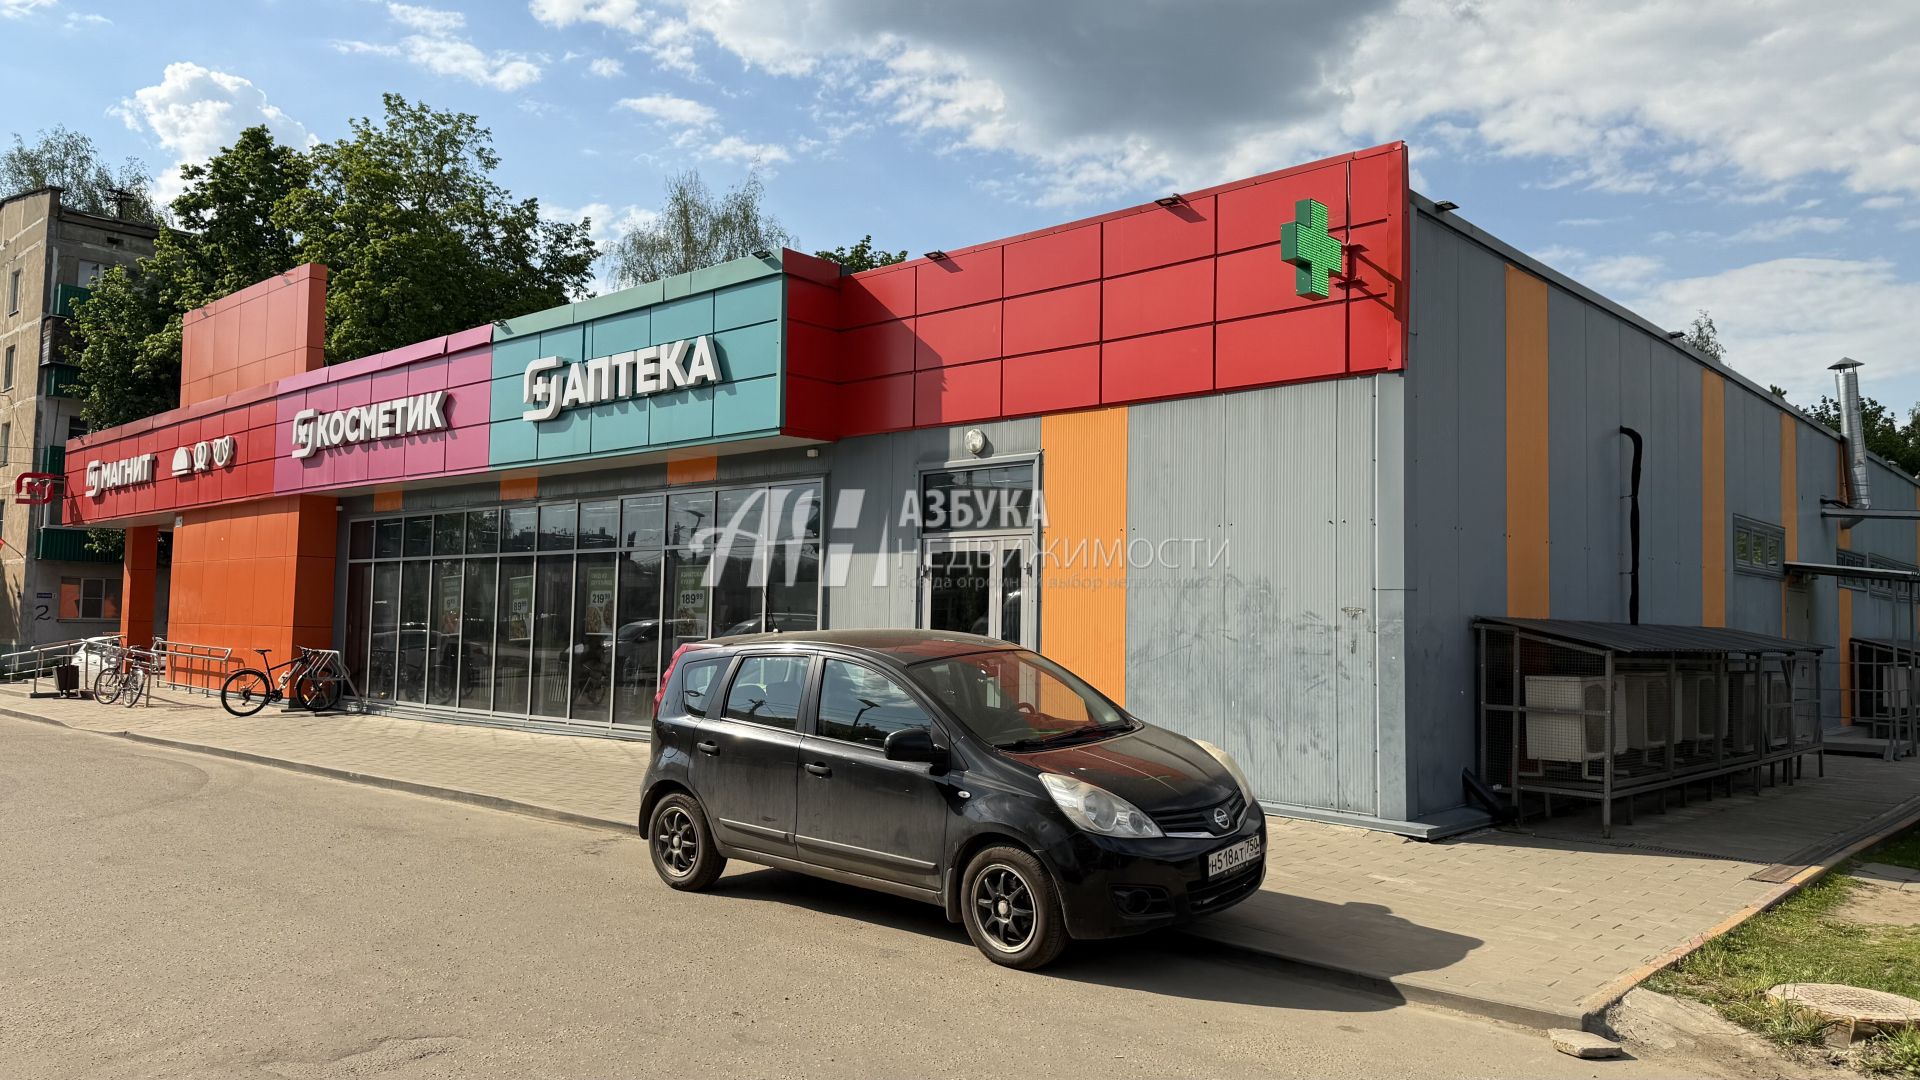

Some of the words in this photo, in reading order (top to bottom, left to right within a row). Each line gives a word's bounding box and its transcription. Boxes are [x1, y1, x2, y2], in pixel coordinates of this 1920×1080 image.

[562, 335, 723, 407] АПТЕКА
[315, 391, 449, 447] КОСМЕТИК
[101, 453, 156, 489] МАГНИТ
[34, 604, 52, 621] 2
